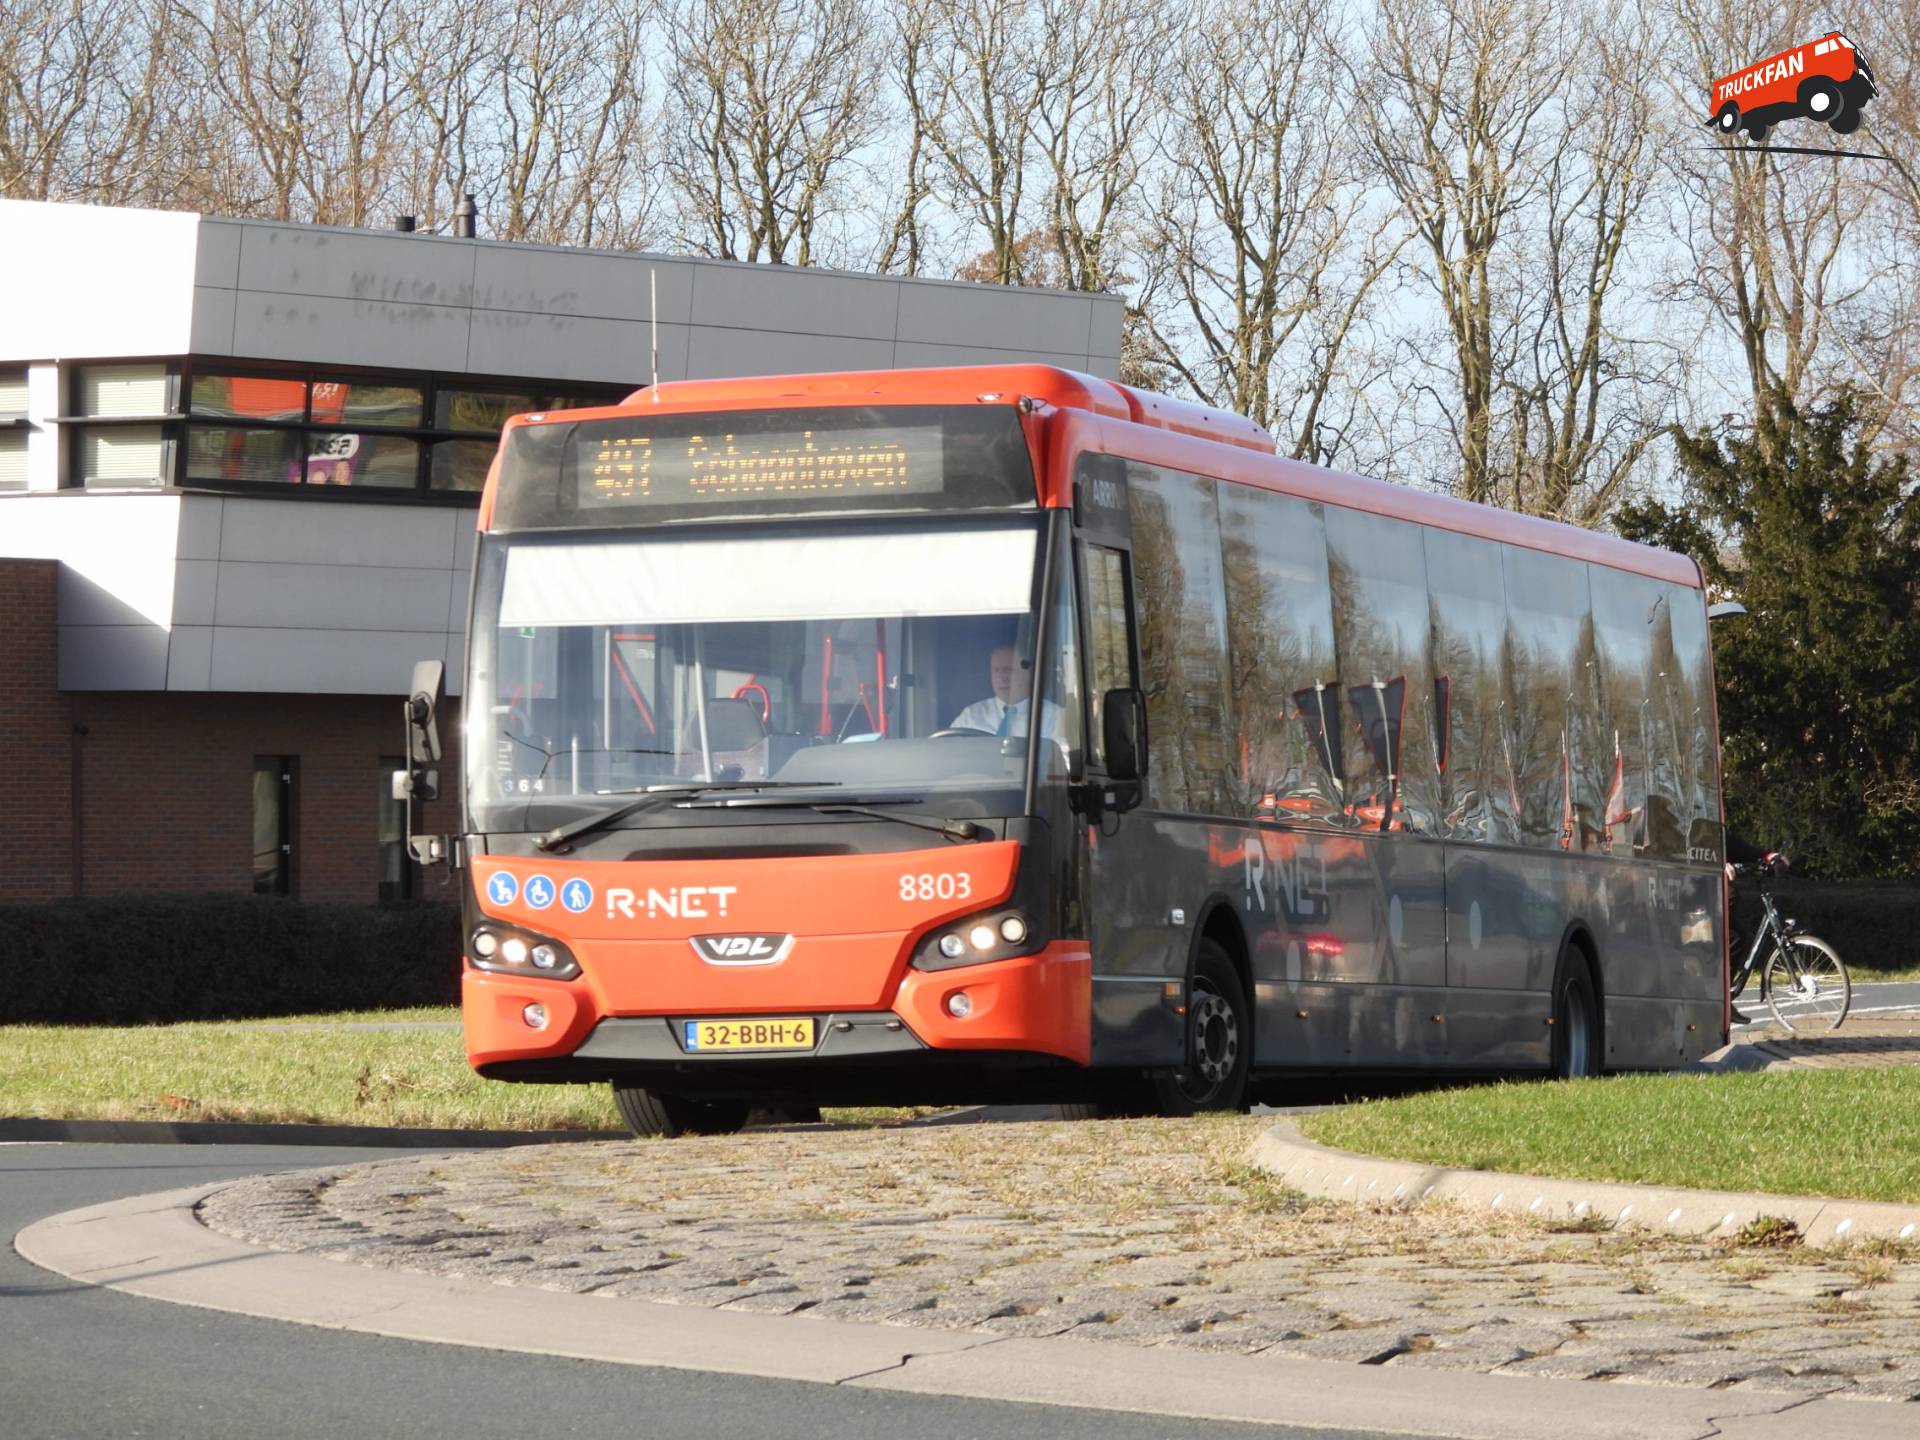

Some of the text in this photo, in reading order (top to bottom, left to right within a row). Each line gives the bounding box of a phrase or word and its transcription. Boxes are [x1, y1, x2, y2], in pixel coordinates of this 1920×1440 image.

[1688, 846, 1718, 863] CITEA
[899, 872, 972, 901] 8803
[705, 936, 775, 958] VDL
[704, 1023, 807, 1047] 32-BBH-6
